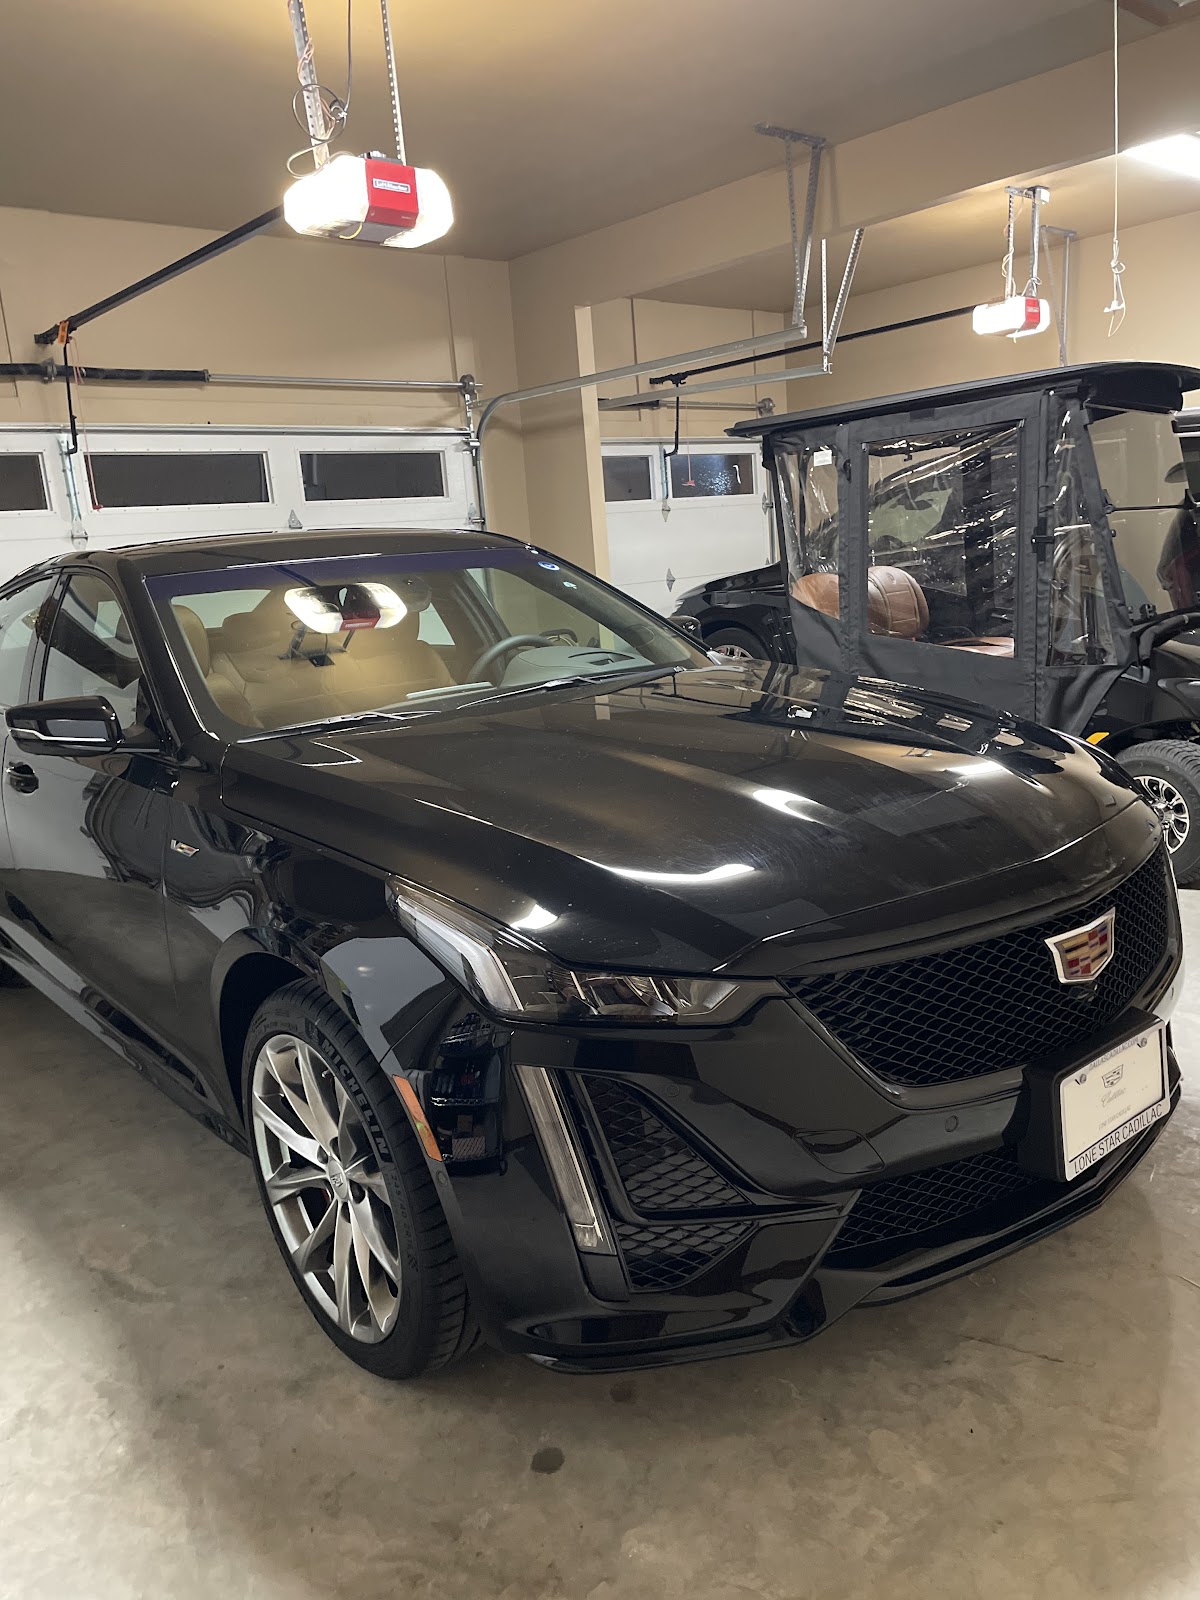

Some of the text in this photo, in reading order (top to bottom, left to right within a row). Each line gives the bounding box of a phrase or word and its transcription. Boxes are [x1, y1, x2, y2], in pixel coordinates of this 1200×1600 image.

[321, 1038, 390, 1155] MICHELIN
[1074, 1103, 1163, 1174] LONE STAR CADILLAC
